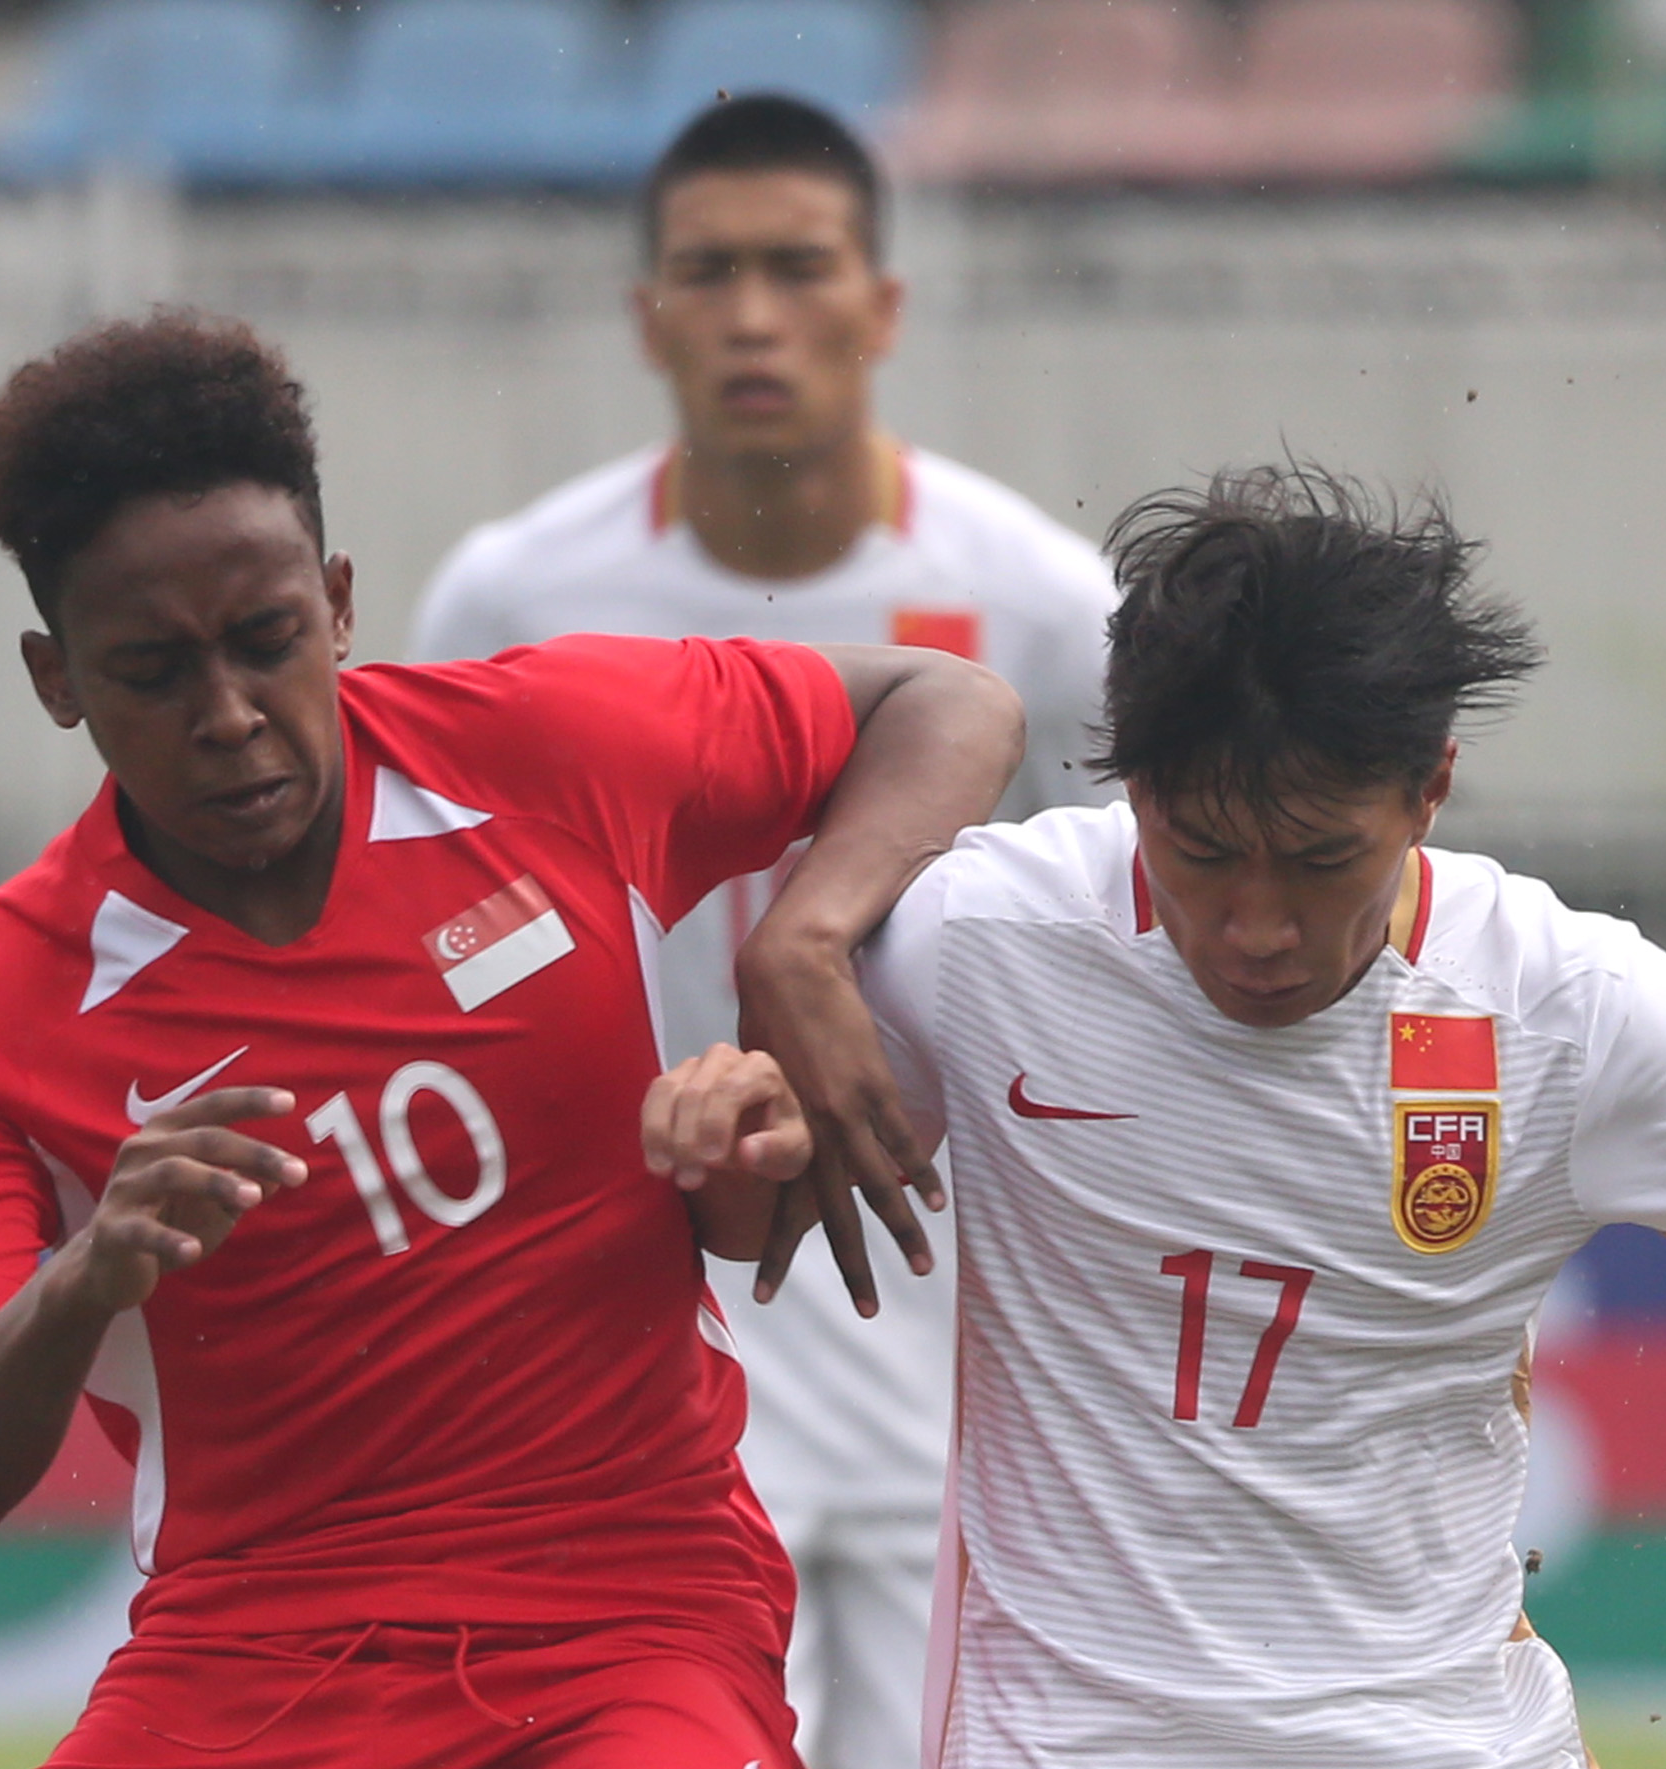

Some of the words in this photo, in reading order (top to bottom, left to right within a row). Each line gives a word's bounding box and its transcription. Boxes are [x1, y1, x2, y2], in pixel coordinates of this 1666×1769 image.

[304, 1060, 507, 1256] 10
[1408, 1115, 1484, 1142] CFA
[1160, 1248, 1315, 1428] 17
